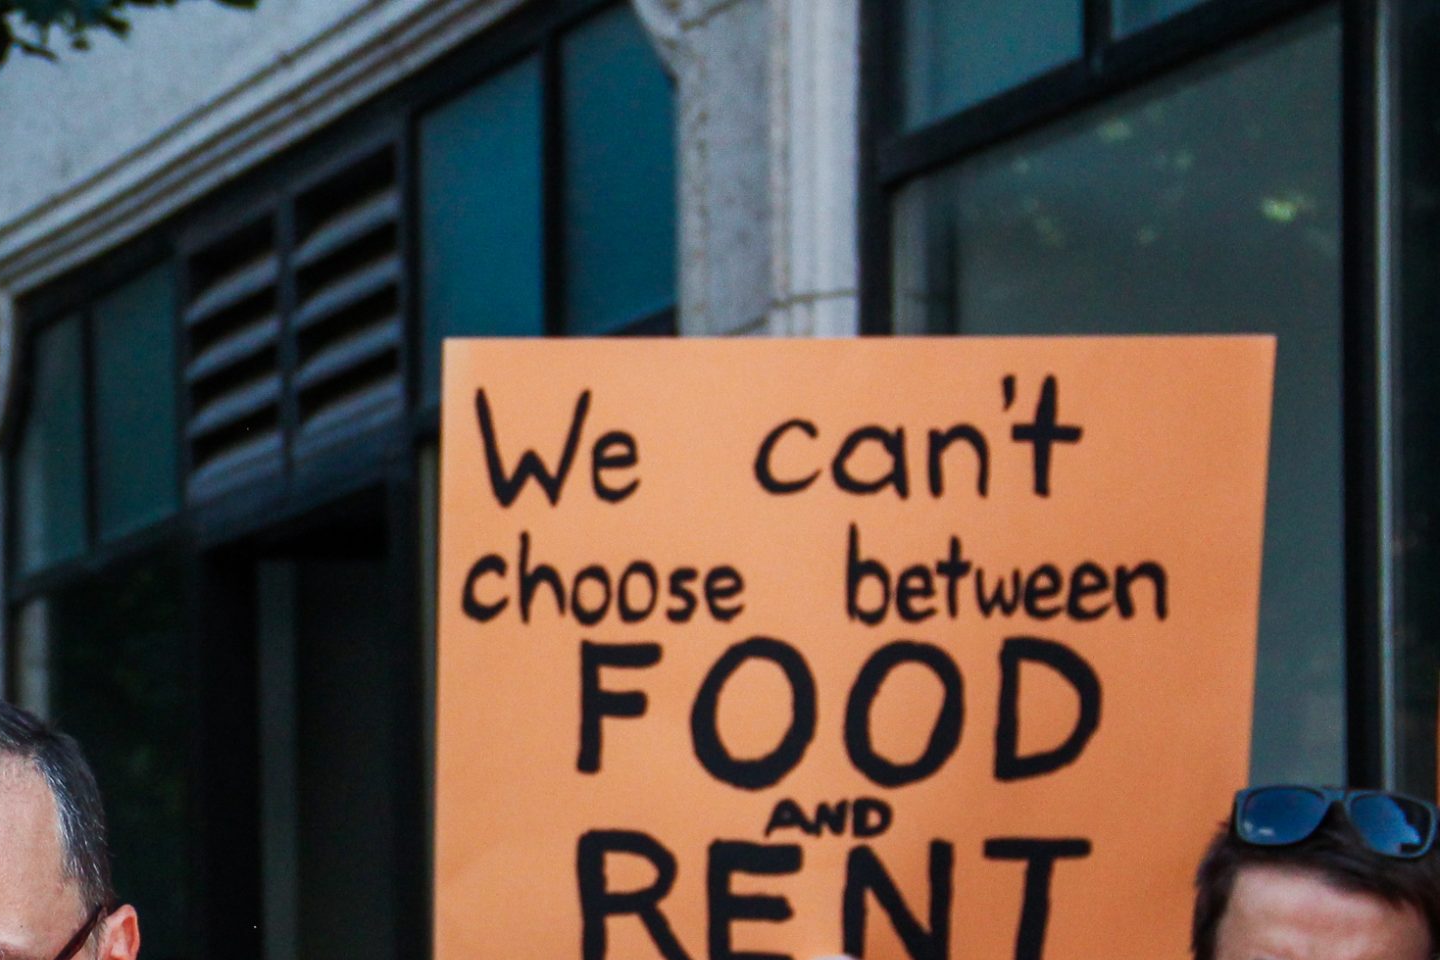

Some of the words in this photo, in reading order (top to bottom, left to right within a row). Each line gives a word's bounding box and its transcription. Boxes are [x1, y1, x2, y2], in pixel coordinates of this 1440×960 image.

[475, 387, 641, 508] We
[755, 374, 1083, 499] can't
[461, 531, 745, 626] choose
[846, 522, 1168, 626] between
[577, 635, 1101, 790] FOOD
[764, 798, 893, 839] AND
